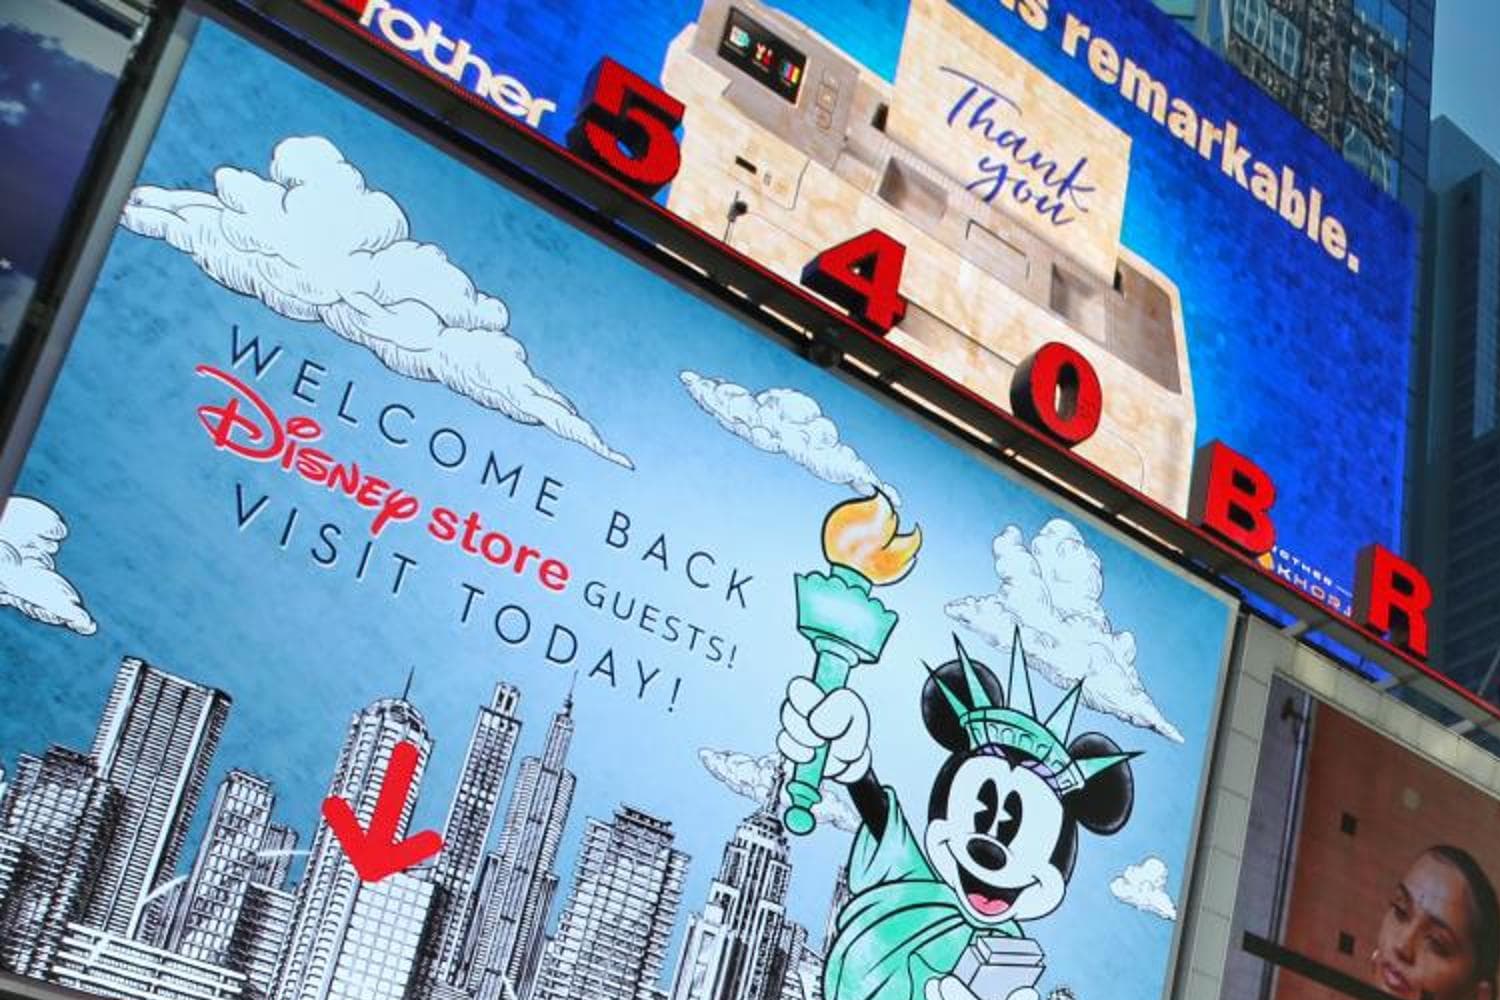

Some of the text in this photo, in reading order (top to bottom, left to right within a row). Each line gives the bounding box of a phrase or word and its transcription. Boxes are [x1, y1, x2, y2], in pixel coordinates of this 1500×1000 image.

[939, 65, 1097, 213] Thank
[965, 150, 1077, 228] you
[1061, 13, 1360, 274] remarkable.
[196, 364, 739, 670] Disney store GUESTS!
[230, 324, 756, 609] WELCOME BACK
[234, 482, 682, 714] VISIT TODAY!
